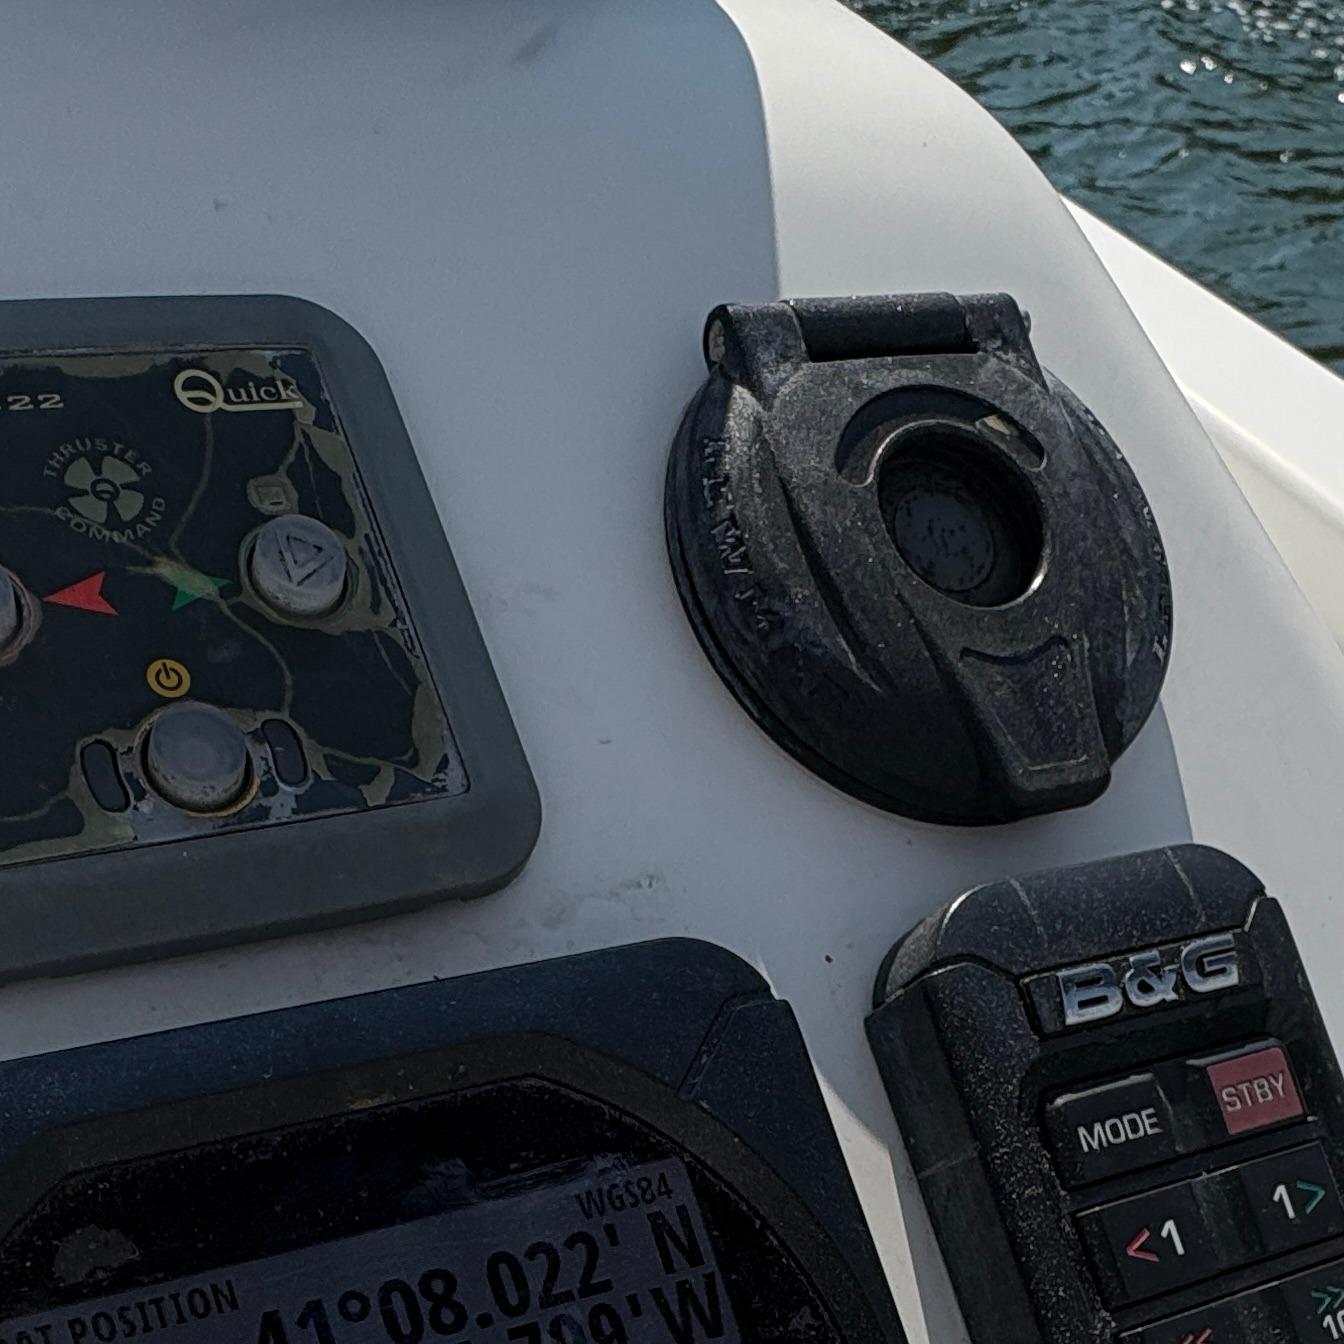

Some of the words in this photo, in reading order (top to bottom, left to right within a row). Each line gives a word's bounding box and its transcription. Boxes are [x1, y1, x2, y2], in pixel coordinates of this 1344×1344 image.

[173, 368, 303, 413] Quick
[43, 437, 153, 478] THRUSTER
[55, 496, 166, 544] COMMAND
[1058, 932, 1242, 1027] B&G
[1220, 1070, 1287, 1114] STBY
[1077, 1107, 1162, 1153] MODE
[574, 1172, 673, 1220] WGS84
[646, 1204, 705, 1275] N
